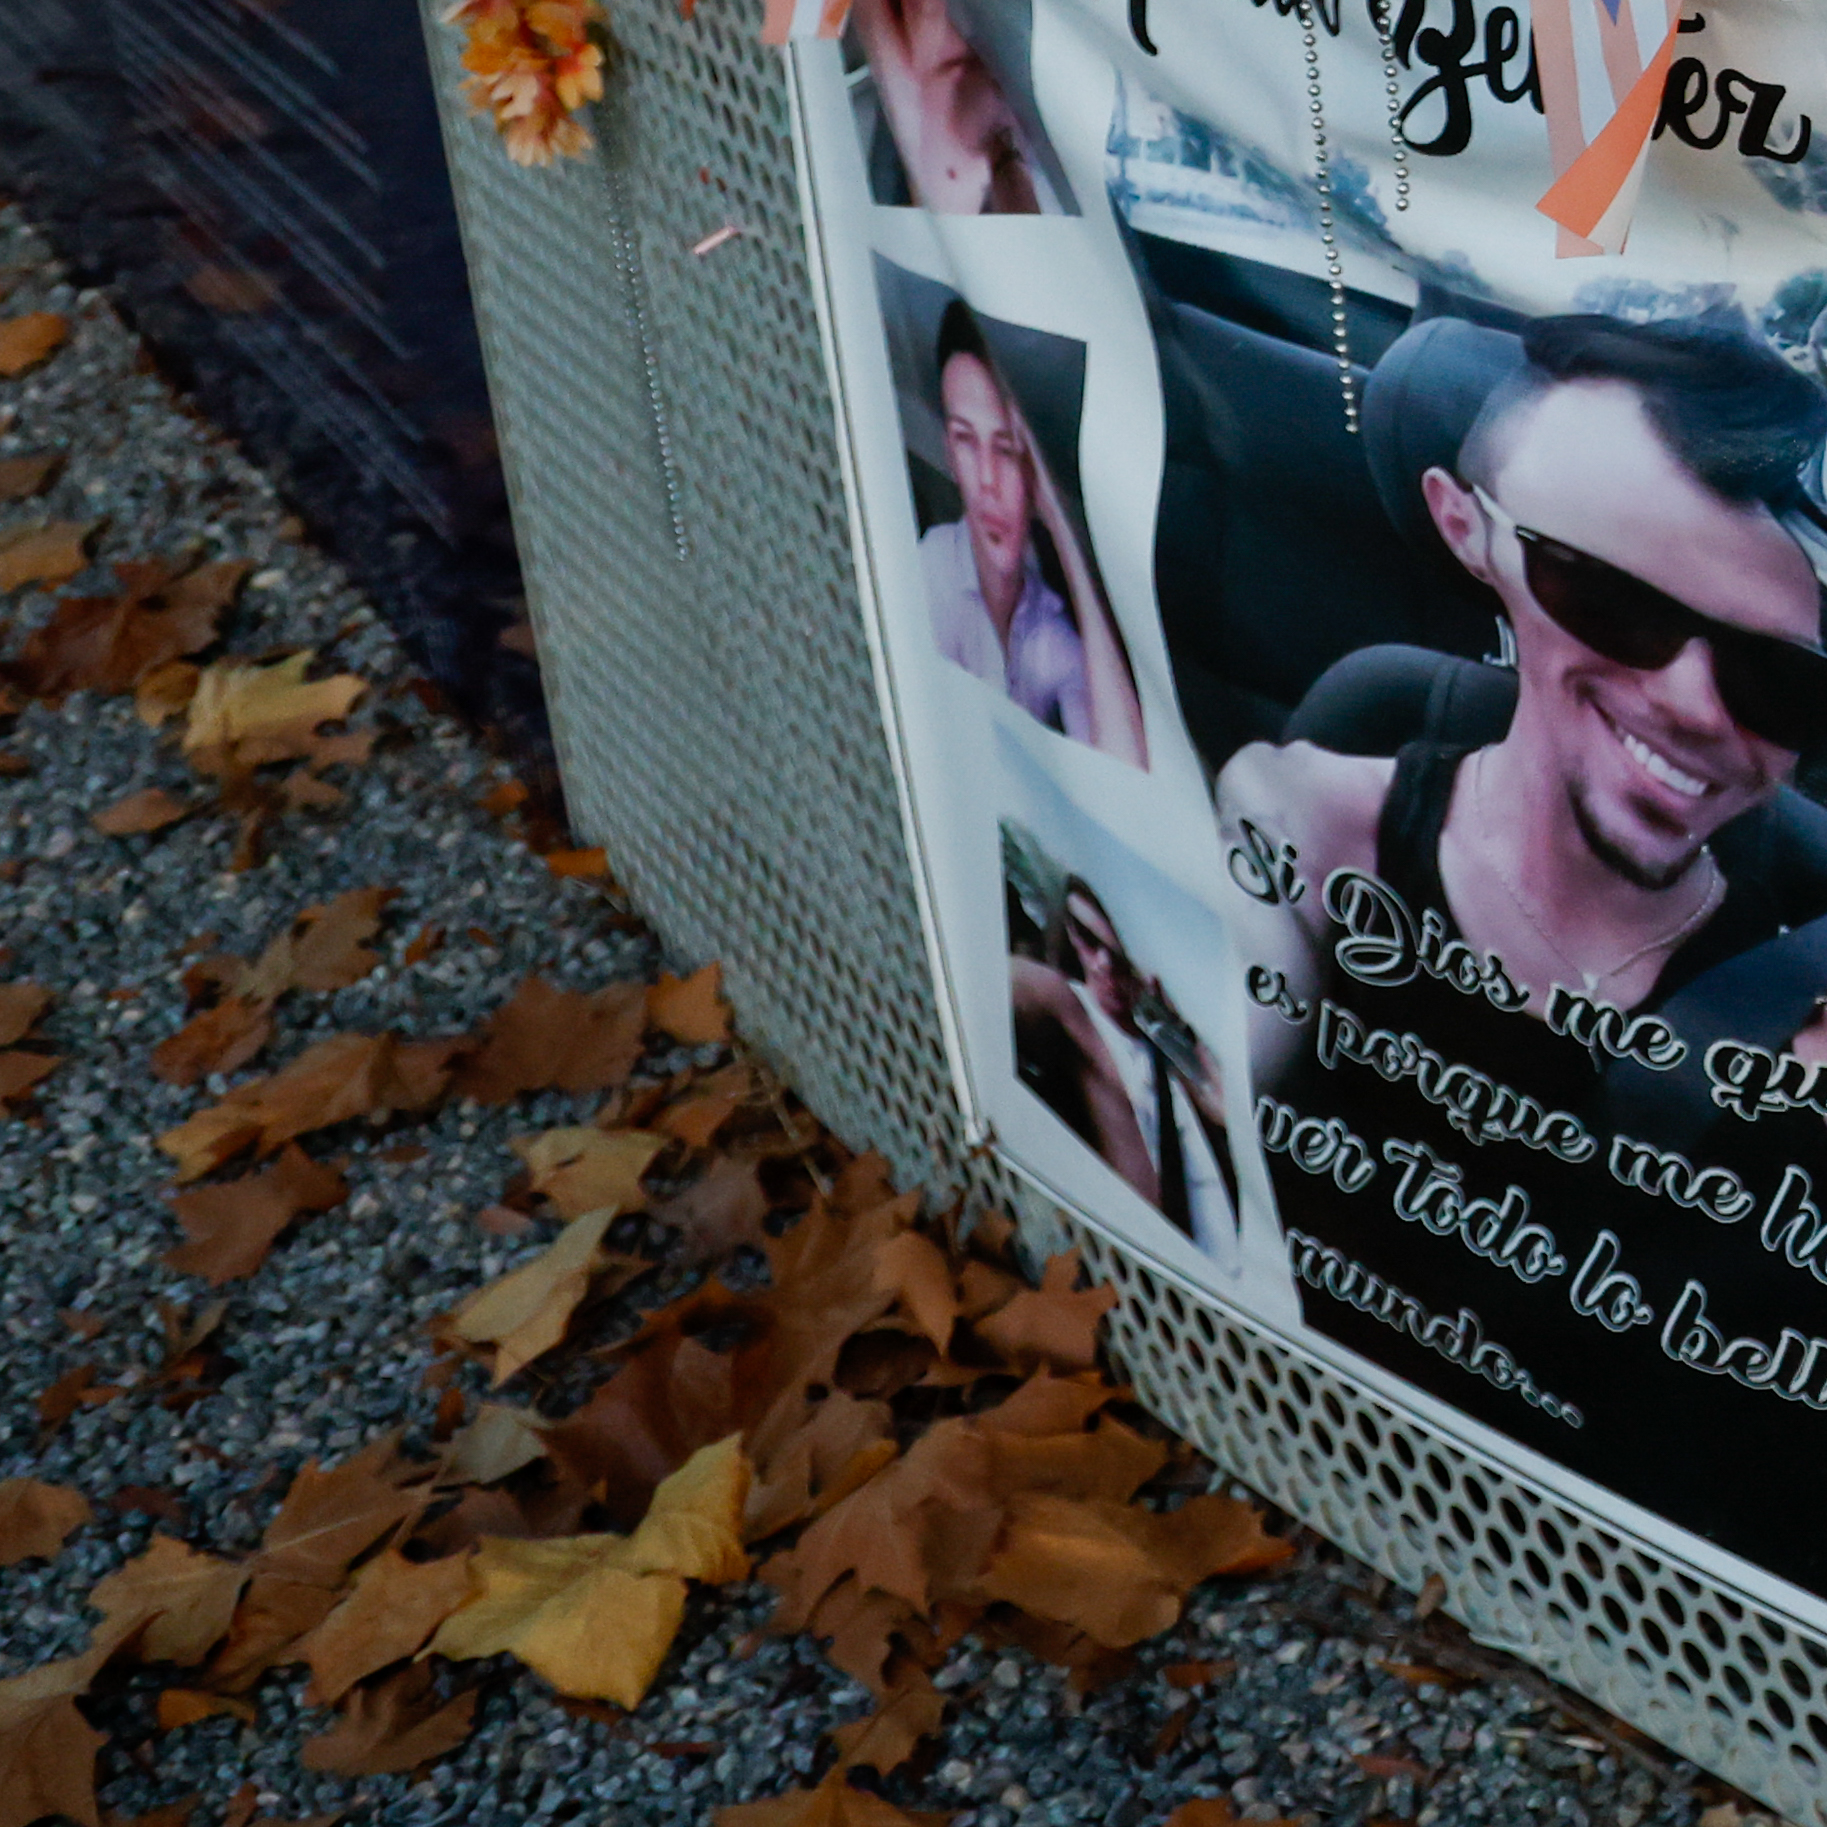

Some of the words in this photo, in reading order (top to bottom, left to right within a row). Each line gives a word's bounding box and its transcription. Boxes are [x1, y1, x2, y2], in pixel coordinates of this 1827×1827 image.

[1227, 818, 1305, 906] Si
[1321, 866, 1530, 1012] Dios
[1545, 982, 1686, 1071] me
[1246, 964, 1307, 1023] es
[1317, 998, 1598, 1163] porque
[1608, 1133, 1755, 1225] me
[1255, 1095, 1377, 1192] ver
[1570, 1228, 1654, 1332] lo
[1286, 1227, 1585, 1430] mundo...
